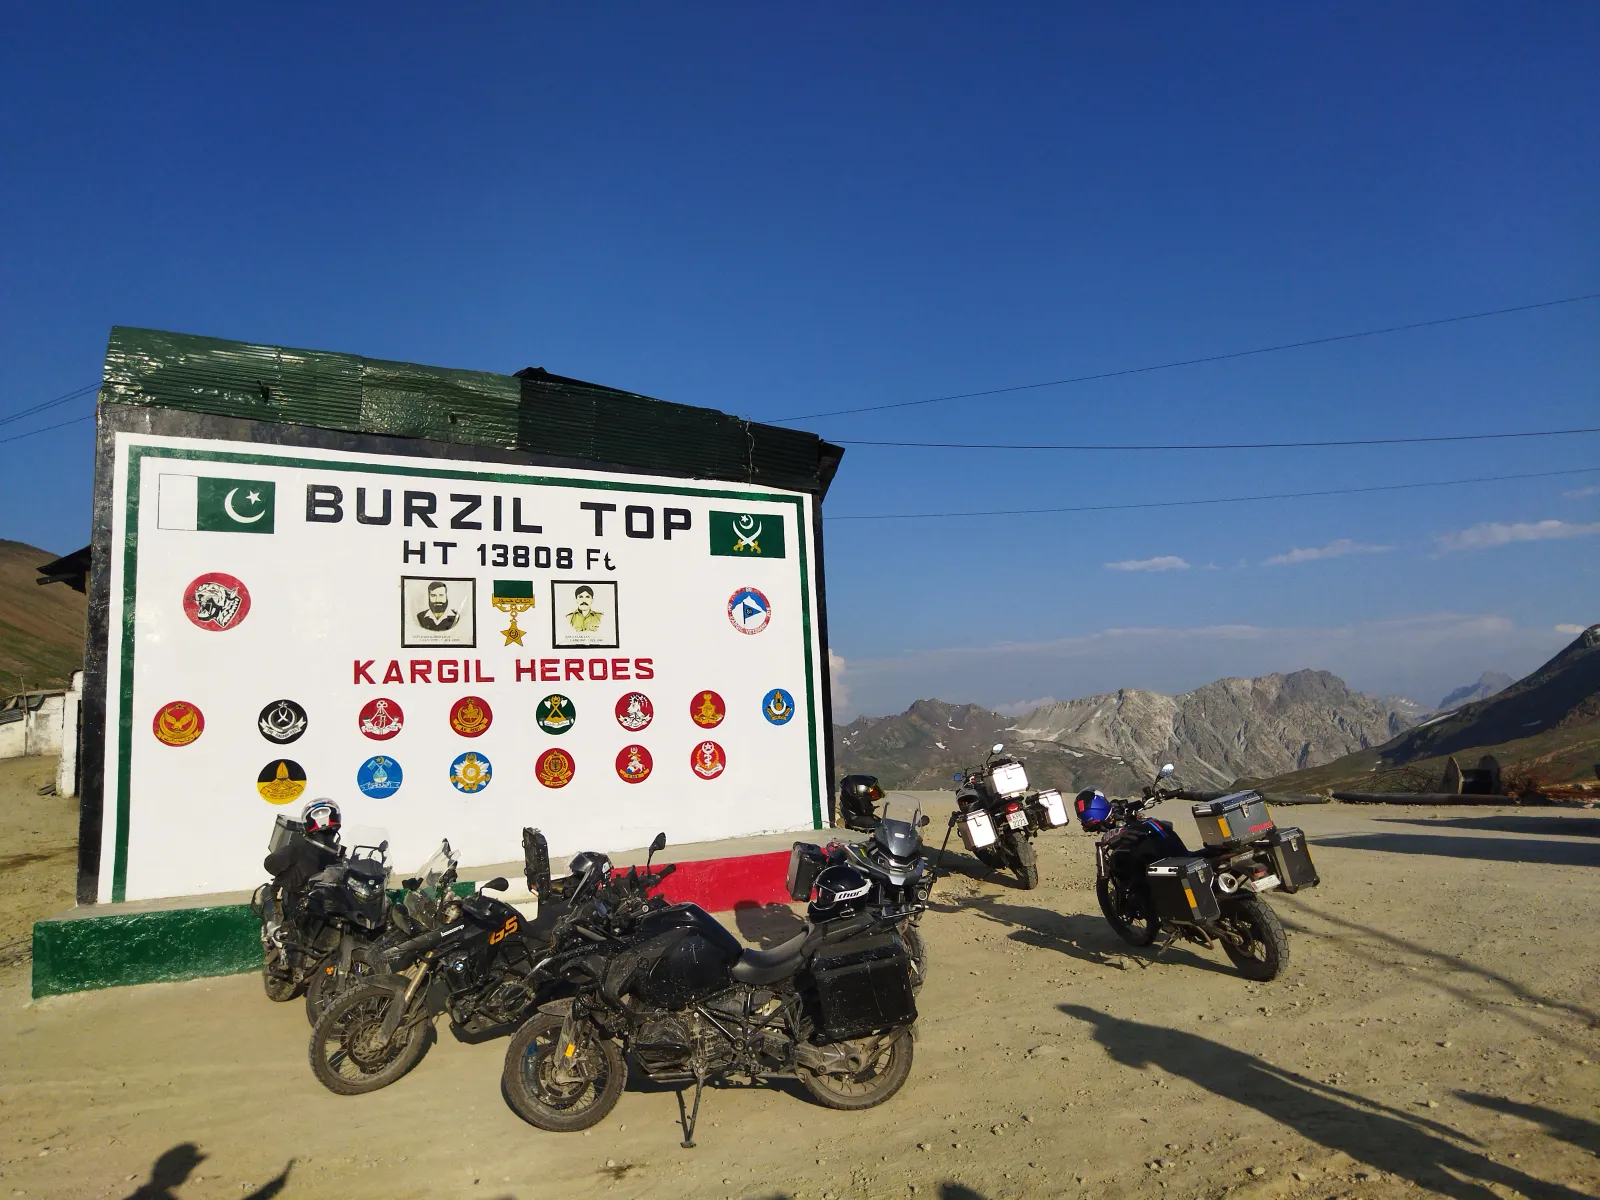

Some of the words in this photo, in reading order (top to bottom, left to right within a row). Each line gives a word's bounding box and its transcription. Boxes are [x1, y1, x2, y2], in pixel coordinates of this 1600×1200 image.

[305, 483, 543, 533] BURZIL
[581, 502, 691, 540] TOP
[404, 541, 457, 564] HT
[477, 544, 572, 569] 13808
[587, 549, 616, 570] Ft
[354, 660, 494, 684] KARGIL
[516, 658, 654, 682] HEROES
[837, 889, 863, 900] thor
